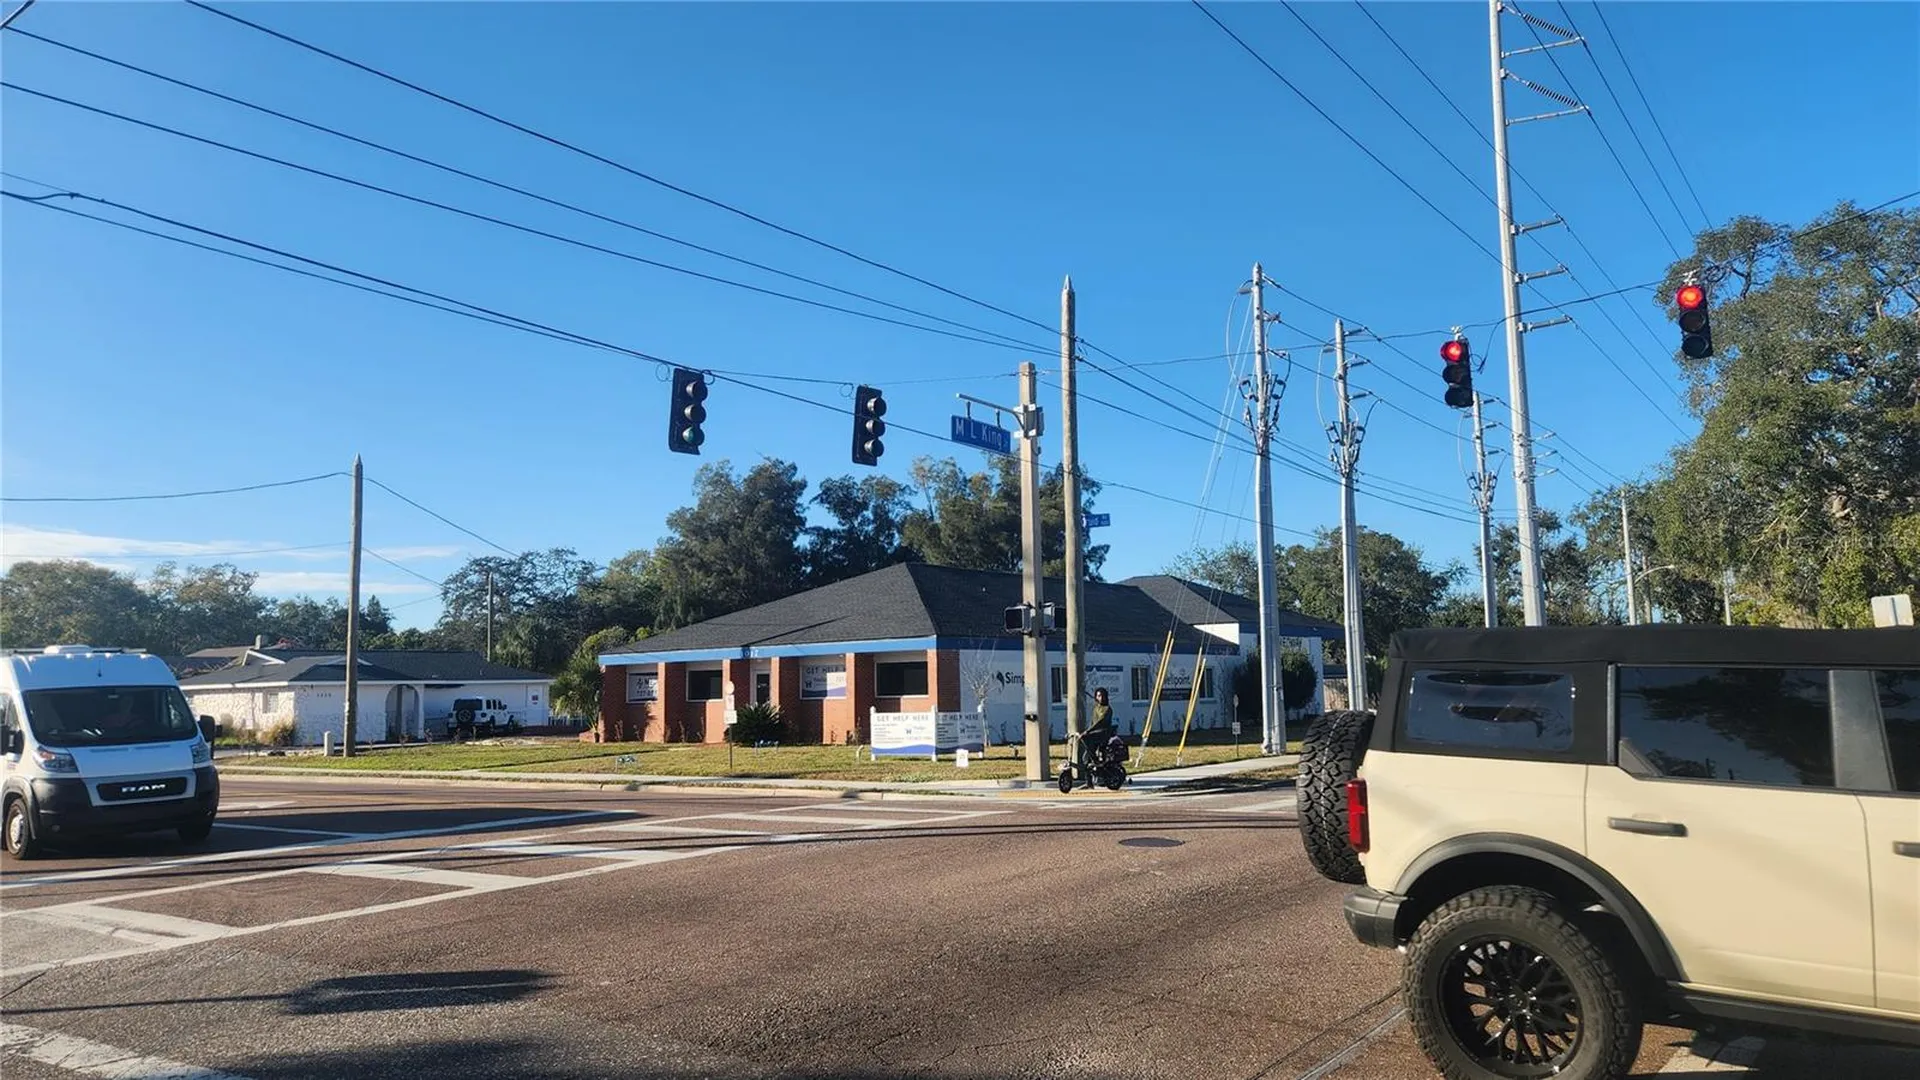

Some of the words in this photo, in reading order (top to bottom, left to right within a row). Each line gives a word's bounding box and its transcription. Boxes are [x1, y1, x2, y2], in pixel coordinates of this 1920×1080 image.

[956, 418, 964, 436] M
[971, 422, 977, 439] L
[982, 424, 1002, 450] King
[122, 783, 166, 792] RAM
